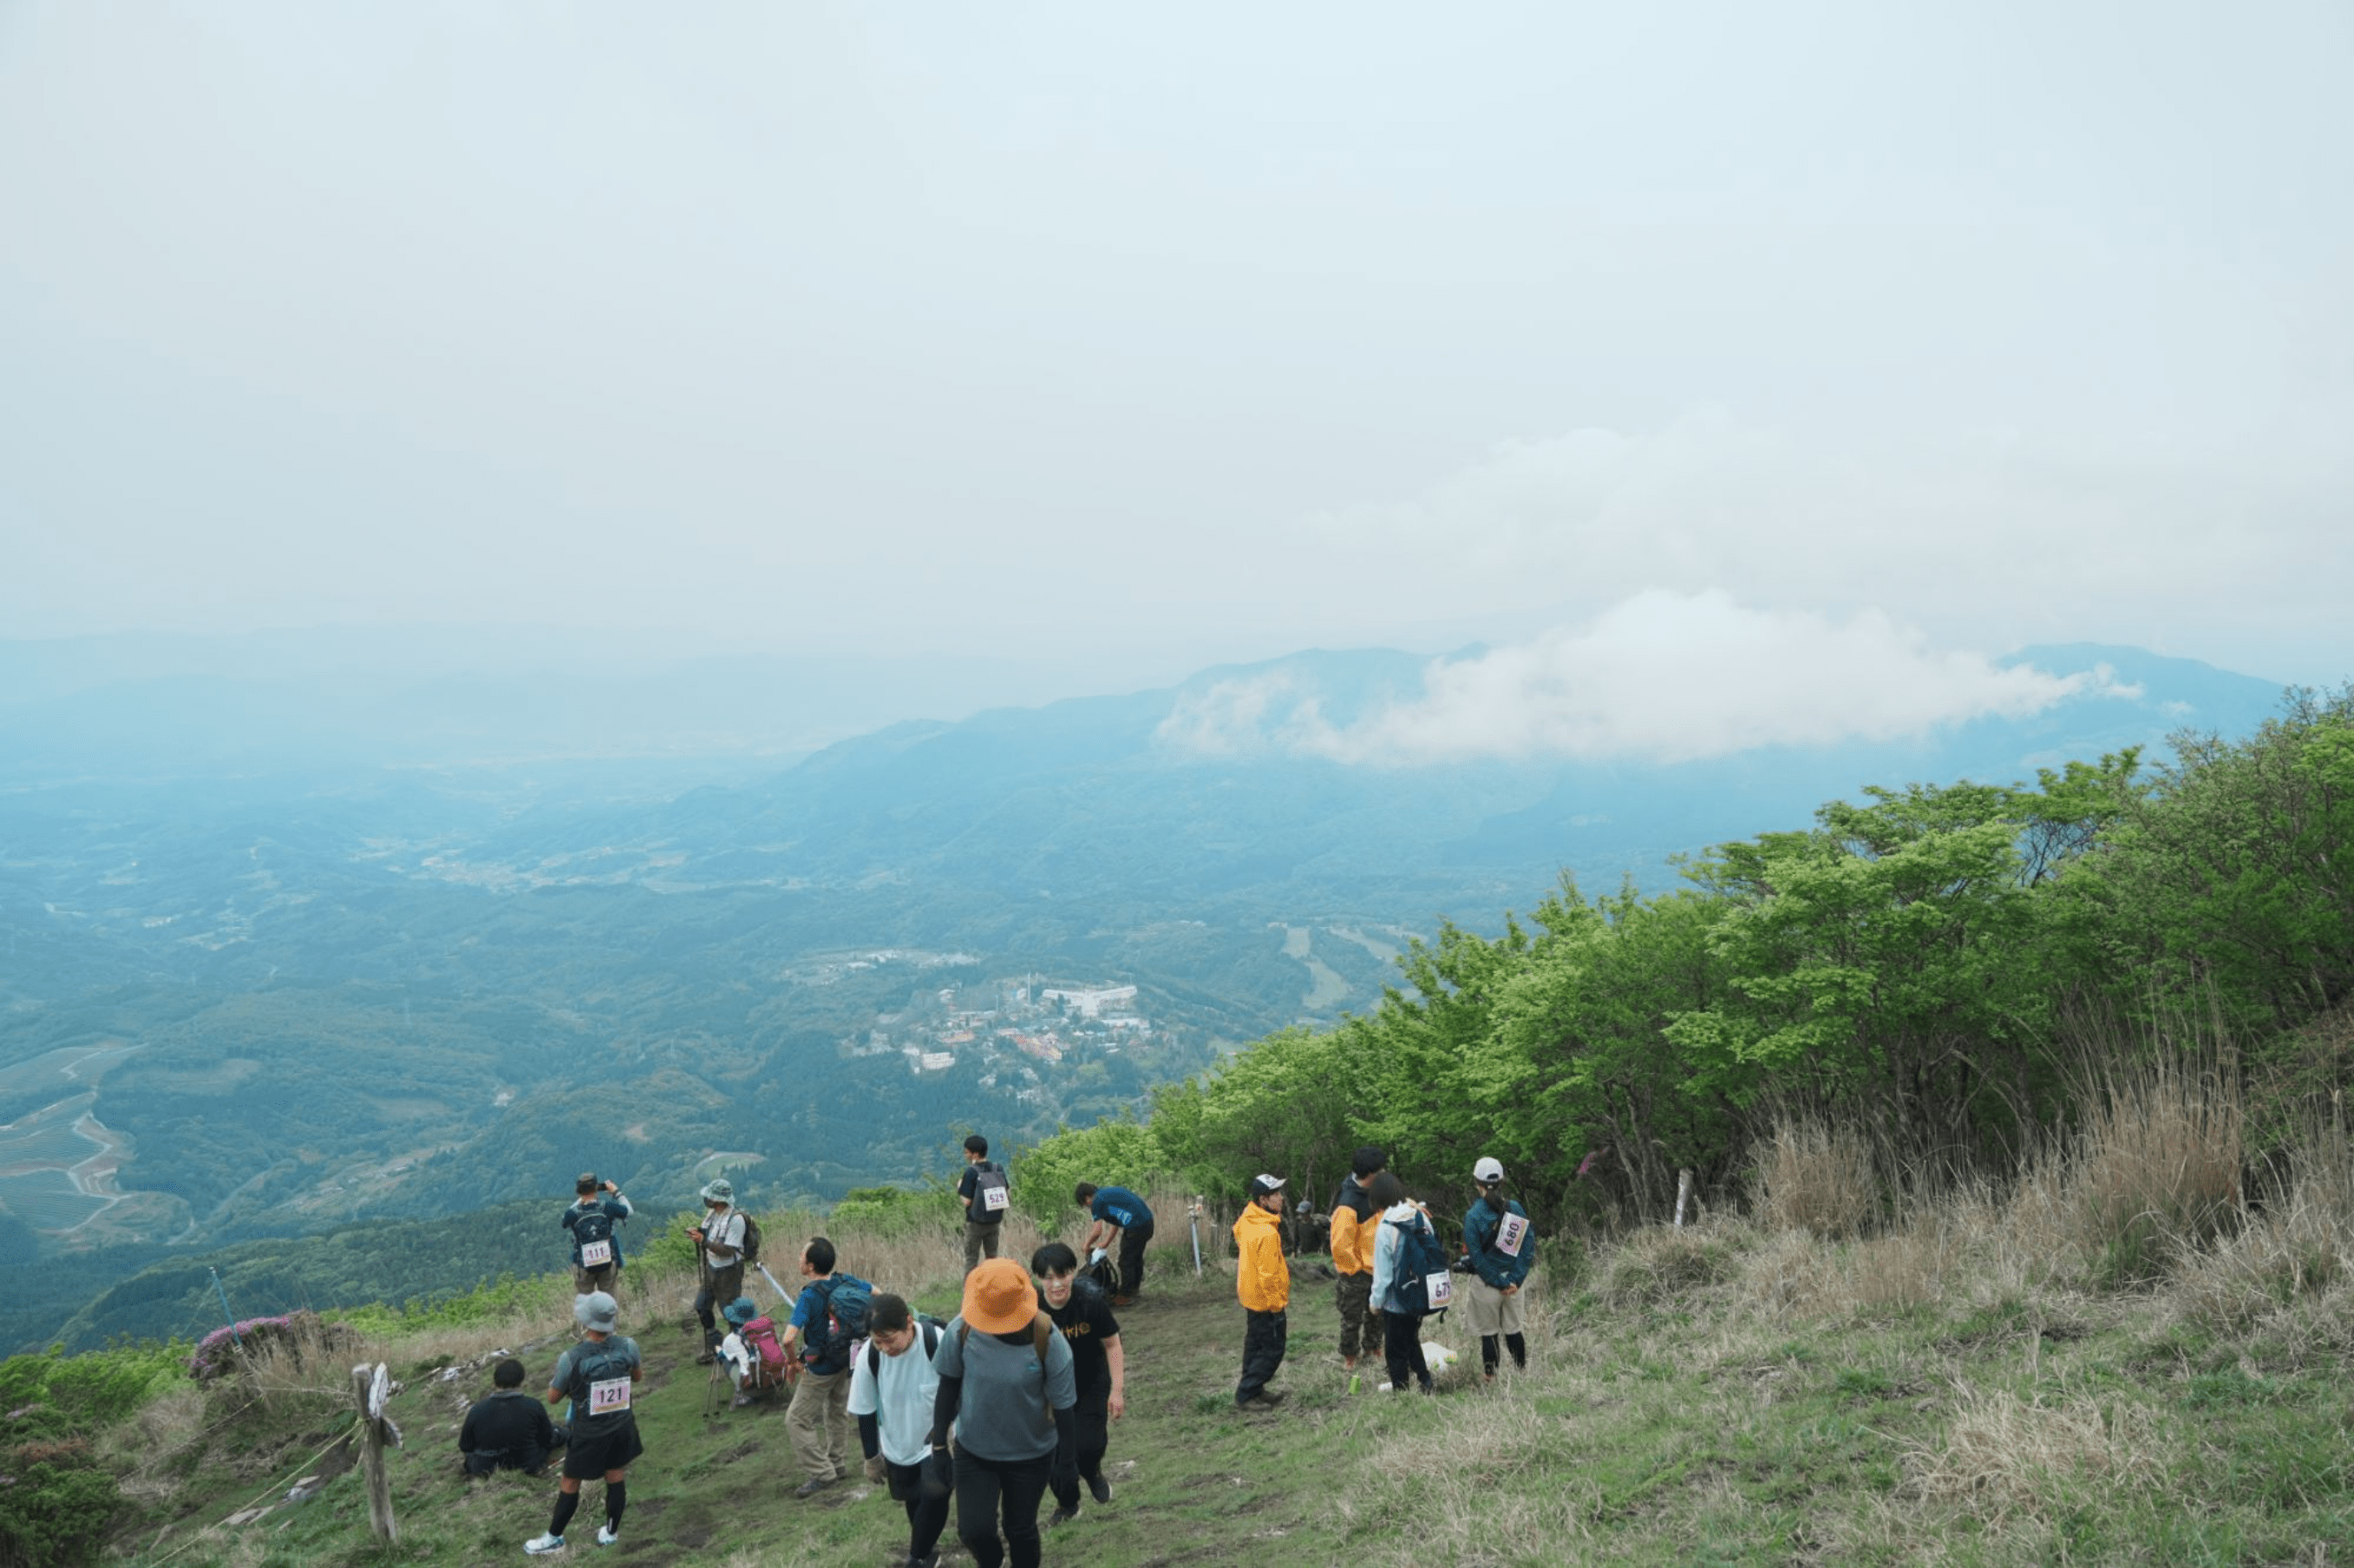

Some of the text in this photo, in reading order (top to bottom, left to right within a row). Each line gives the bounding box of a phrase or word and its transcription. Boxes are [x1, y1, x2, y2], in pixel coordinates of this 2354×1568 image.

[1504, 1223, 1520, 1246] 680
[588, 1247, 605, 1258] 111
[599, 1388, 622, 1403] 121
